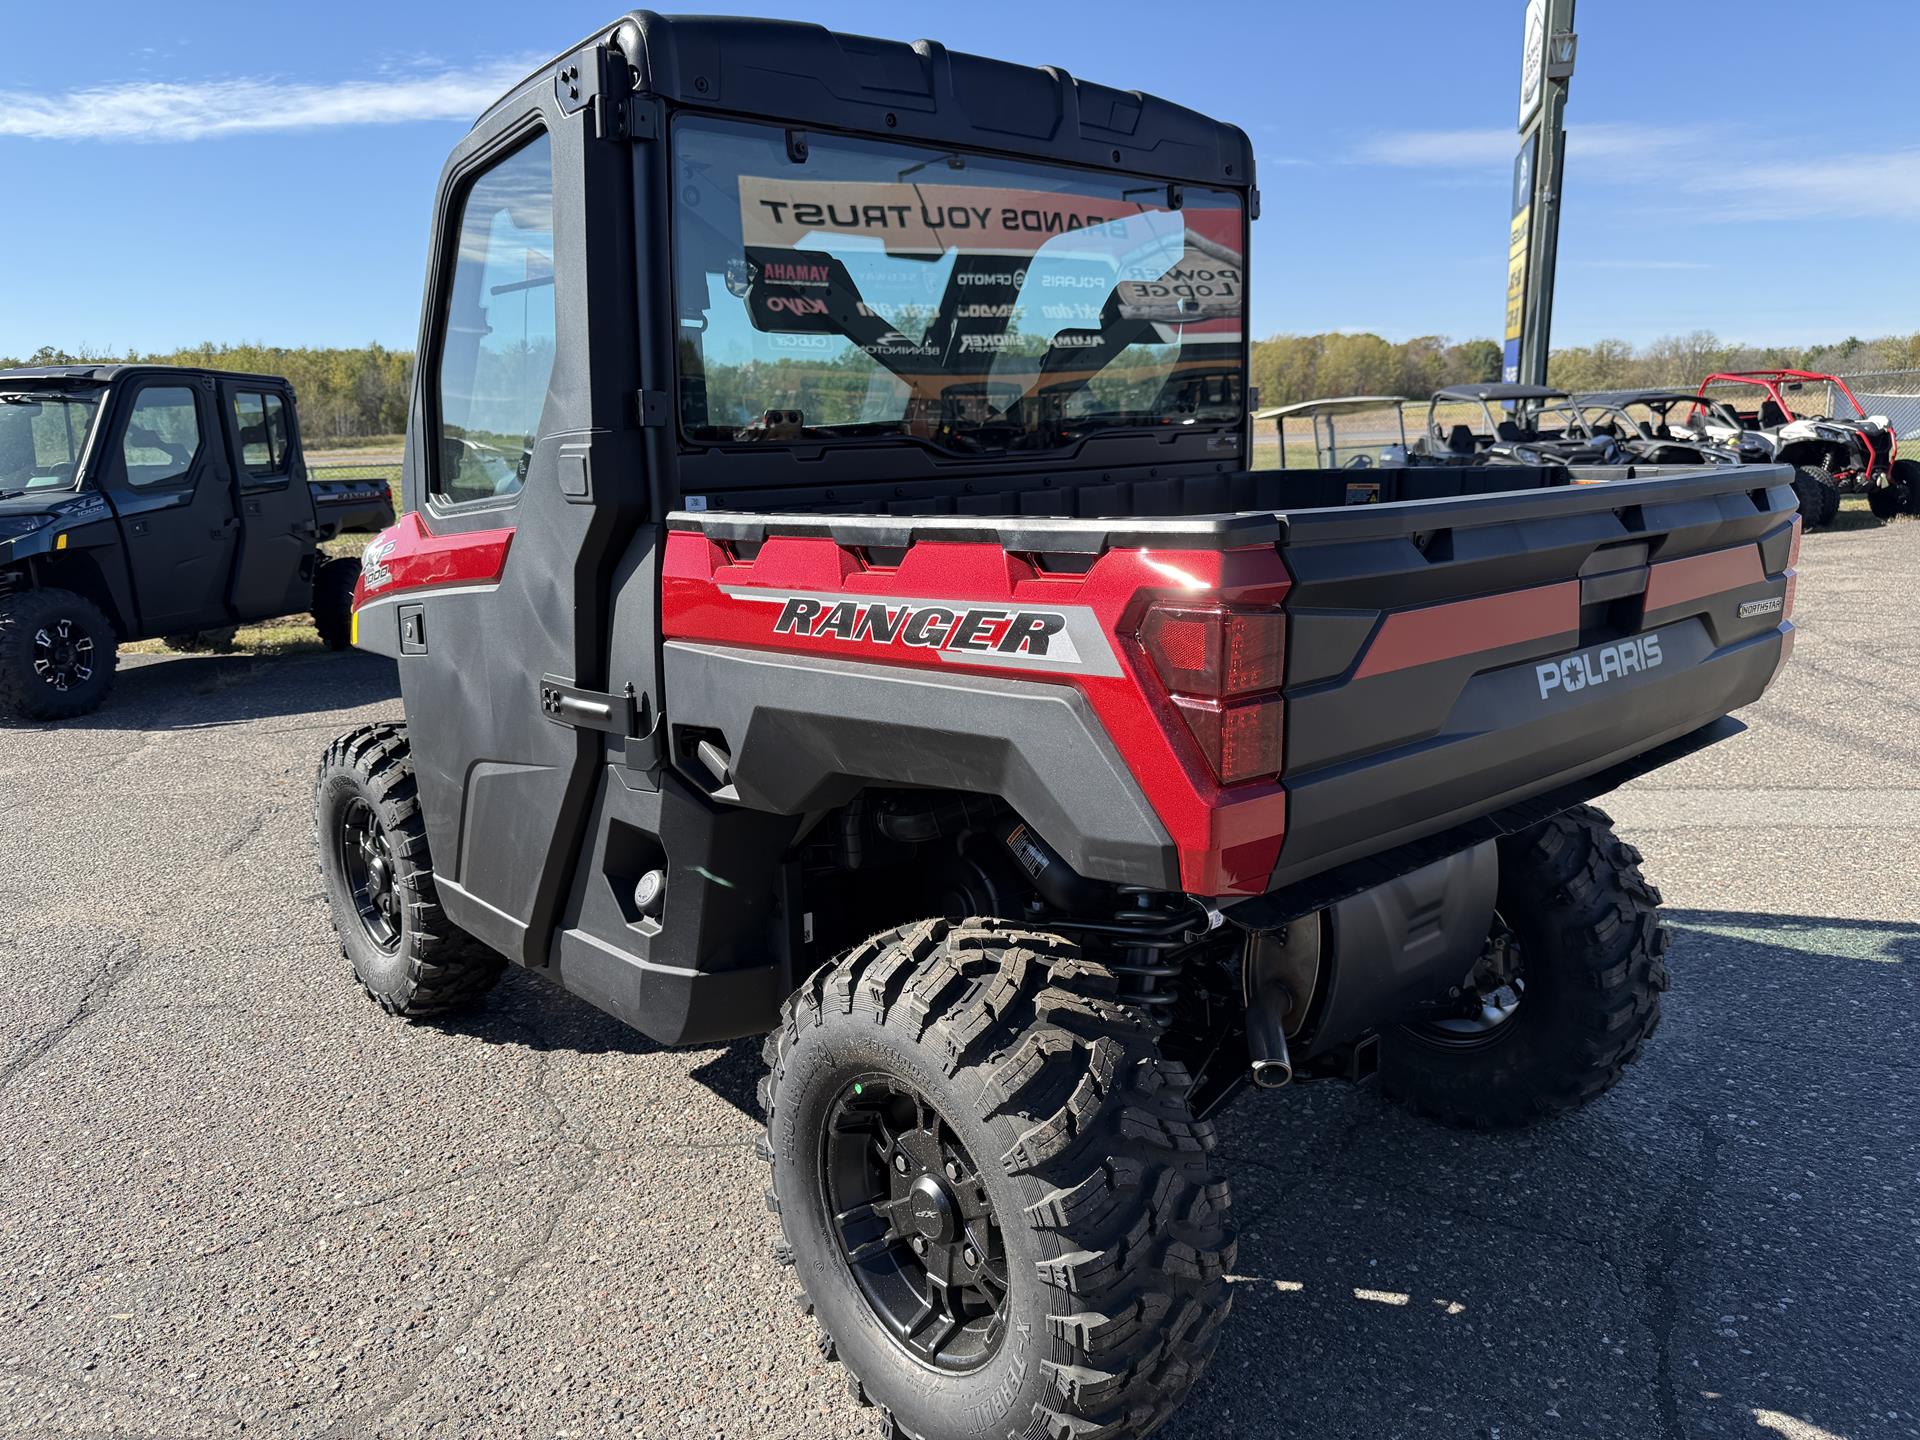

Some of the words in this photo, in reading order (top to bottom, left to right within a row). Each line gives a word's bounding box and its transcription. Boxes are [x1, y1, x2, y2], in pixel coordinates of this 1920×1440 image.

[78, 505, 104, 516] 1000
[366, 566, 388, 584] 1000
[1742, 600, 1781, 615] NORTHSTAR
[773, 597, 1067, 656] RANGER
[1536, 634, 1663, 700] POLARIS
